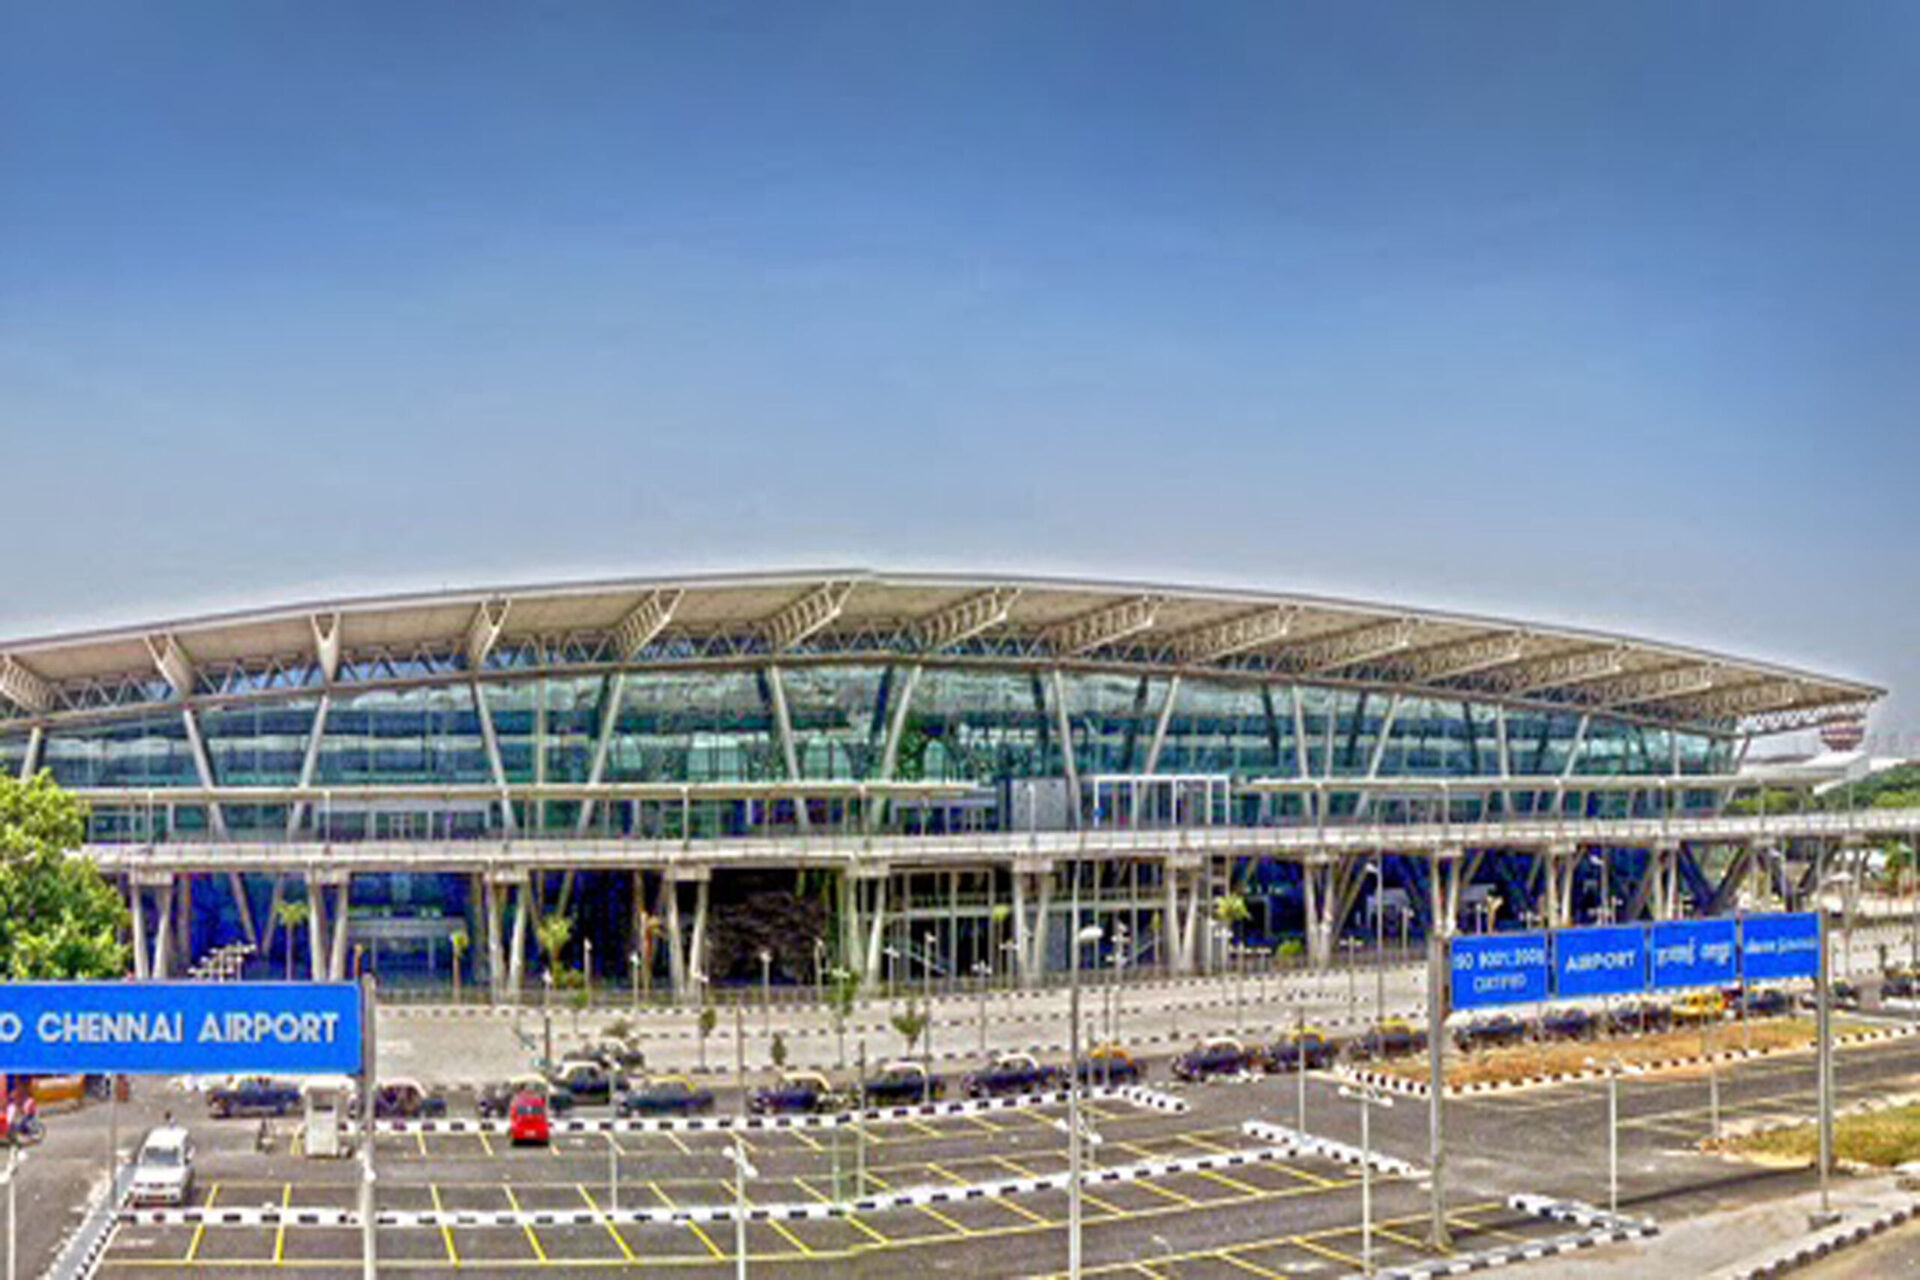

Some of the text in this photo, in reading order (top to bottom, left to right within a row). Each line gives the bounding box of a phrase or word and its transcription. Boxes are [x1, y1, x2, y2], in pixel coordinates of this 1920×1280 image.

[1565, 949, 1637, 973] AIRPORT
[36, 1012, 183, 1043] CHENNAI
[198, 1012, 340, 1043] AIRPORT
